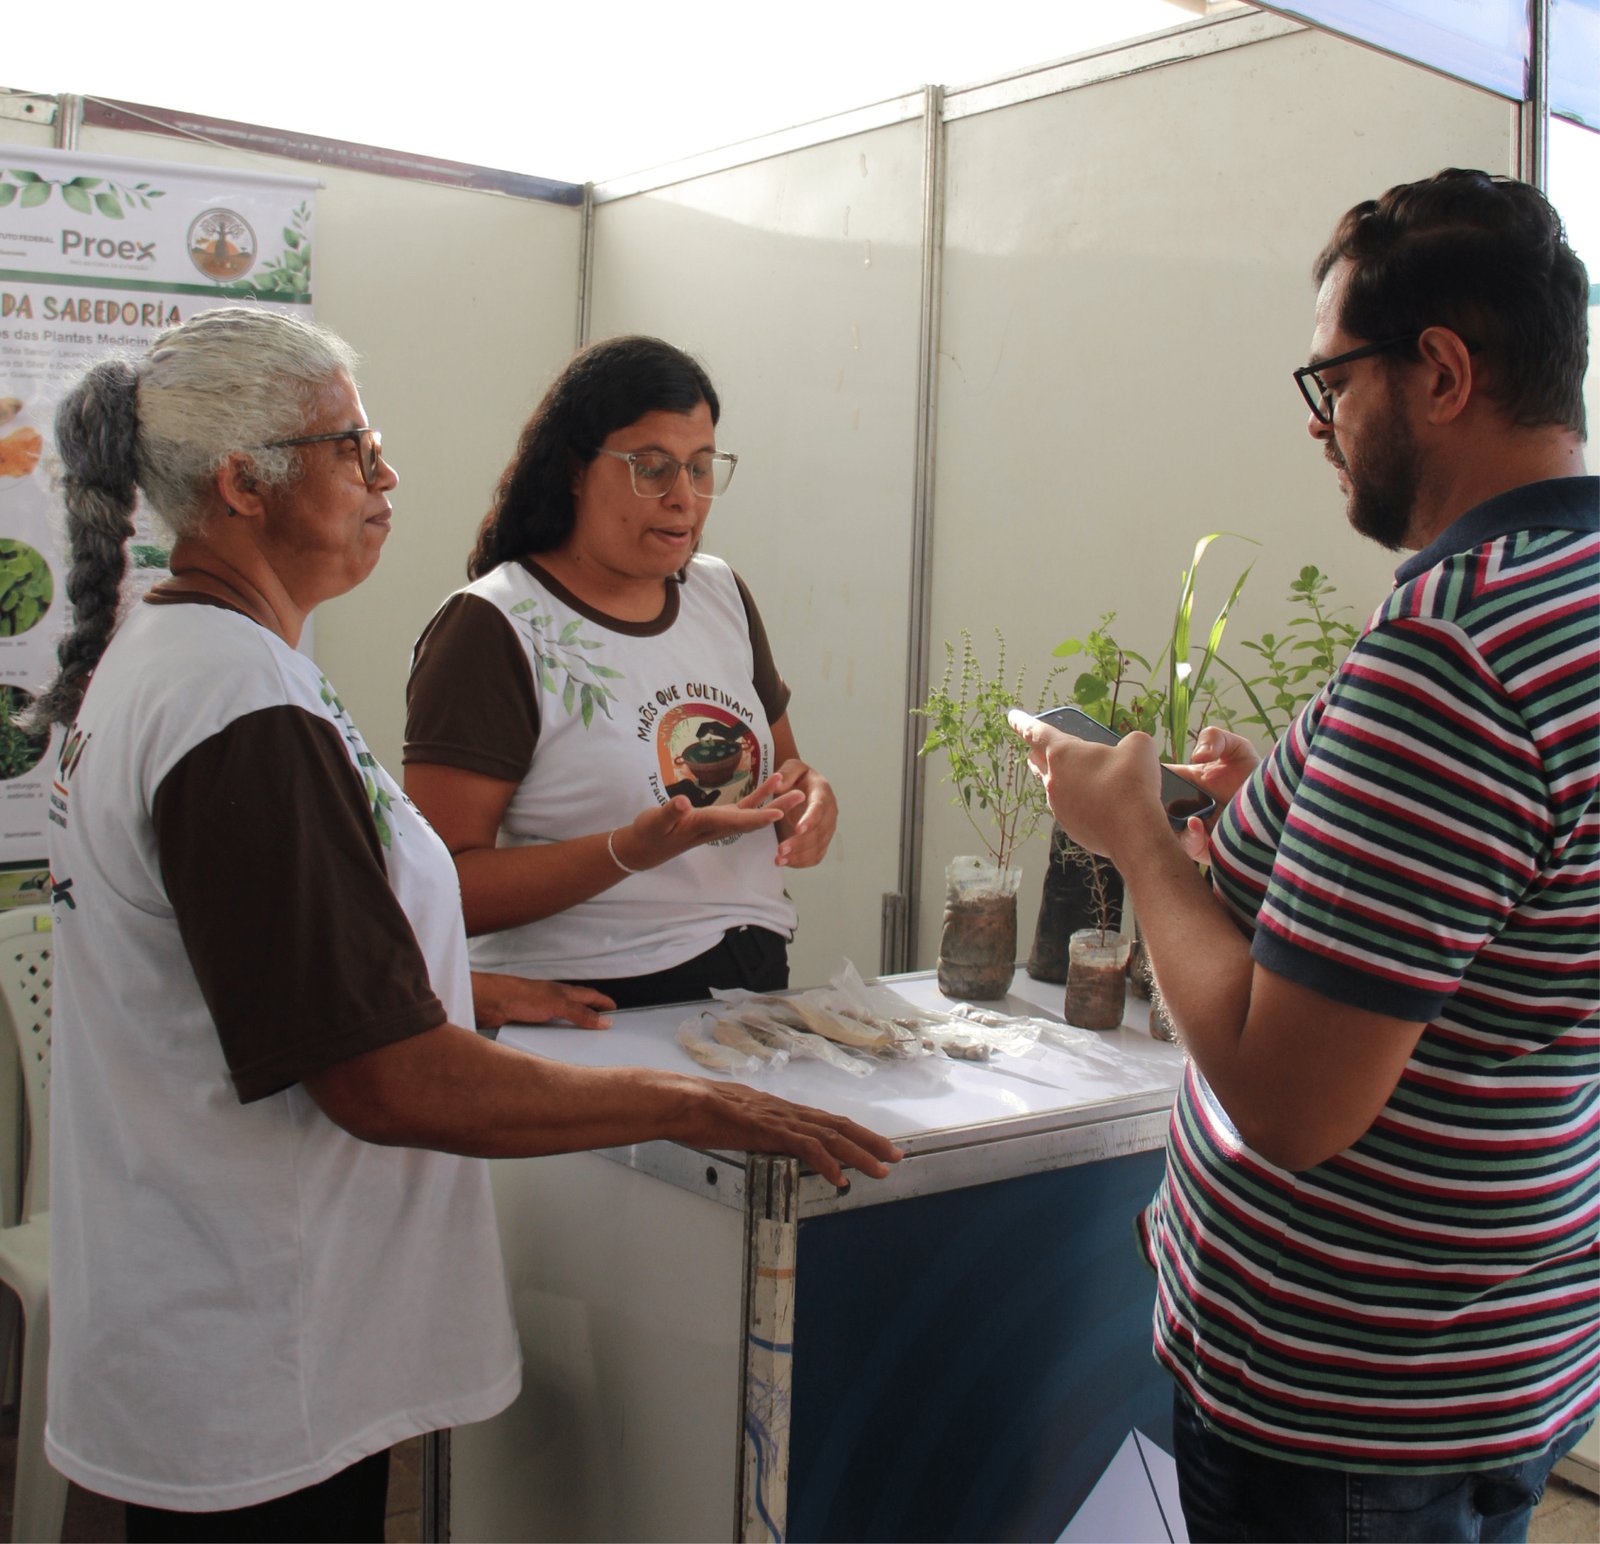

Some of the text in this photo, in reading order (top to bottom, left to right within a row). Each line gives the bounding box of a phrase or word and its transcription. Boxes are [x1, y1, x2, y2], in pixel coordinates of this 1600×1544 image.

[62, 229, 157, 263] Proex
[2, 292, 33, 319] DA
[14, 328, 40, 341] das
[43, 330, 94, 345] Plantas
[655, 685, 681, 706] QUE
[686, 682, 754, 724] CULTIVAM
